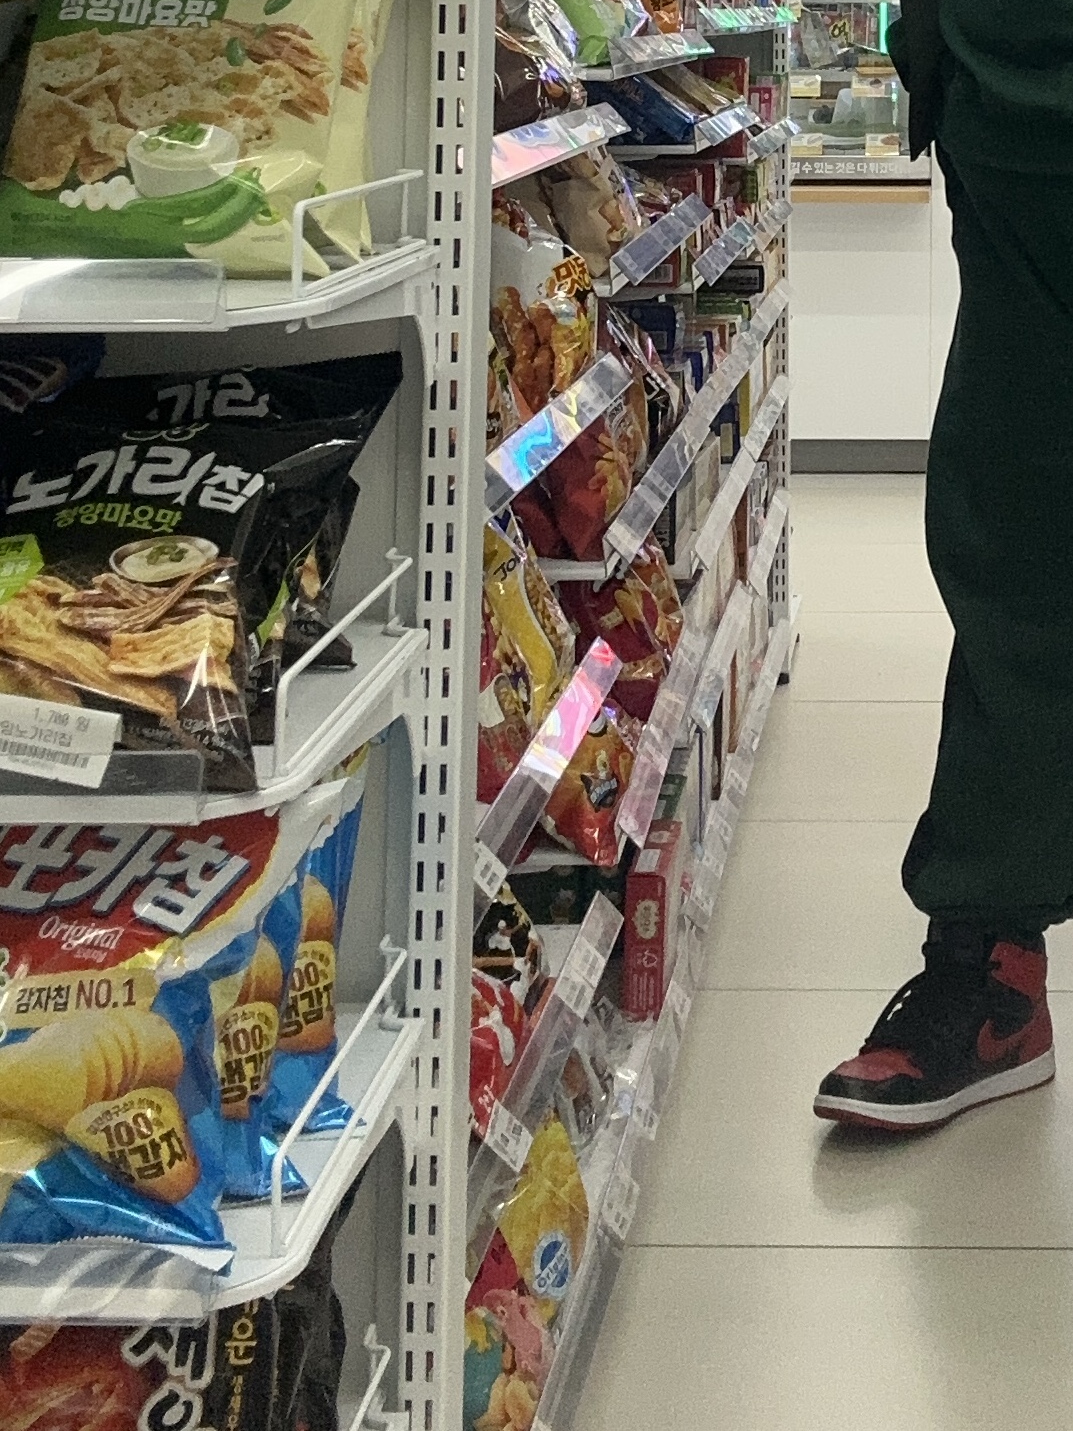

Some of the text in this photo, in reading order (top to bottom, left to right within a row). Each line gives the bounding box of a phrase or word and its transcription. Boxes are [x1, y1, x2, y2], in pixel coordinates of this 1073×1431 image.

[5, 444, 265, 515] 노가리칩
[54, 502, 182, 534] 청양마요맛
[38, 916, 124, 951] Original
[15, 978, 136, 1013] 감자칩 NO.1
